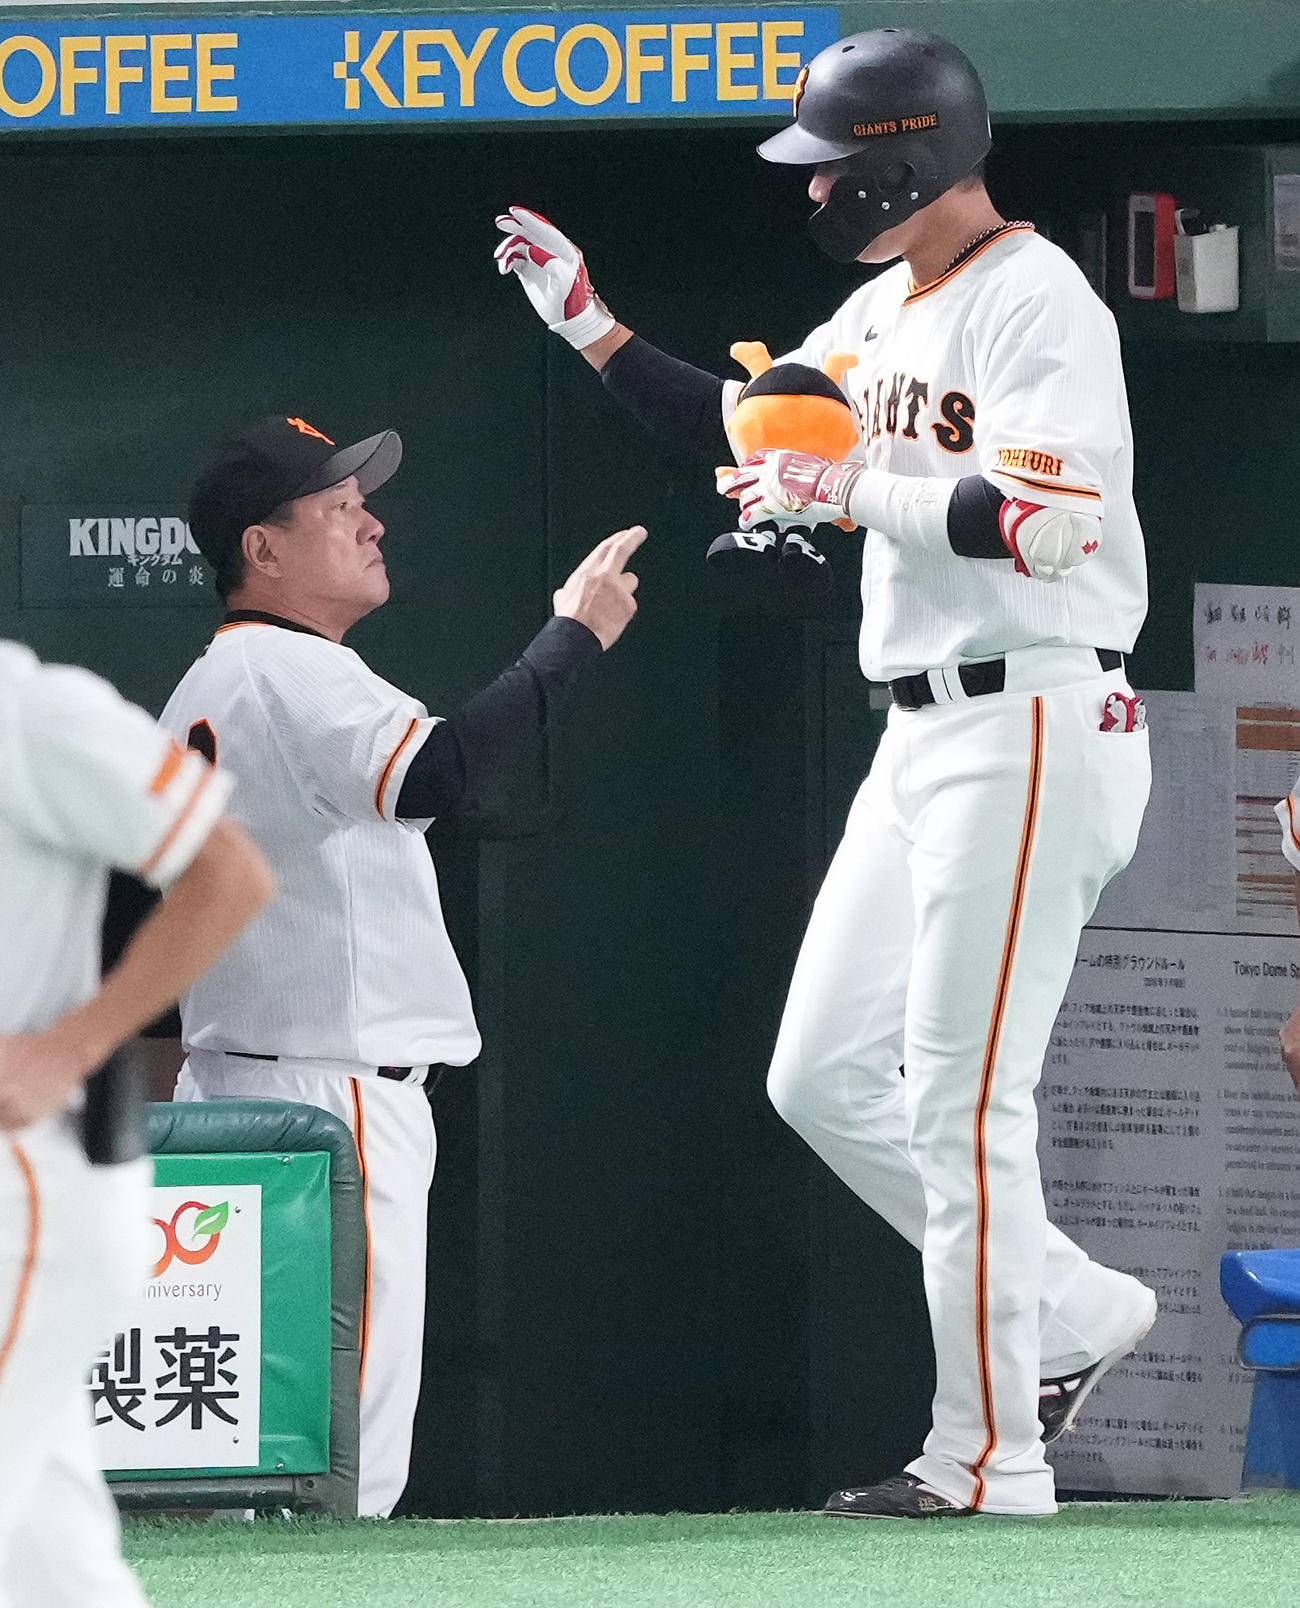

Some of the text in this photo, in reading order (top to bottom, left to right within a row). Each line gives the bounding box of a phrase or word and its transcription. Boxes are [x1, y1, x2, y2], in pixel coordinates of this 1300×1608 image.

[853, 114, 937, 136] GIANTS PRIDE
[108, 566, 204, 587] 運命の炎
[1233, 961, 1260, 977] Tokyo
[1263, 962, 1288, 977] Dome
